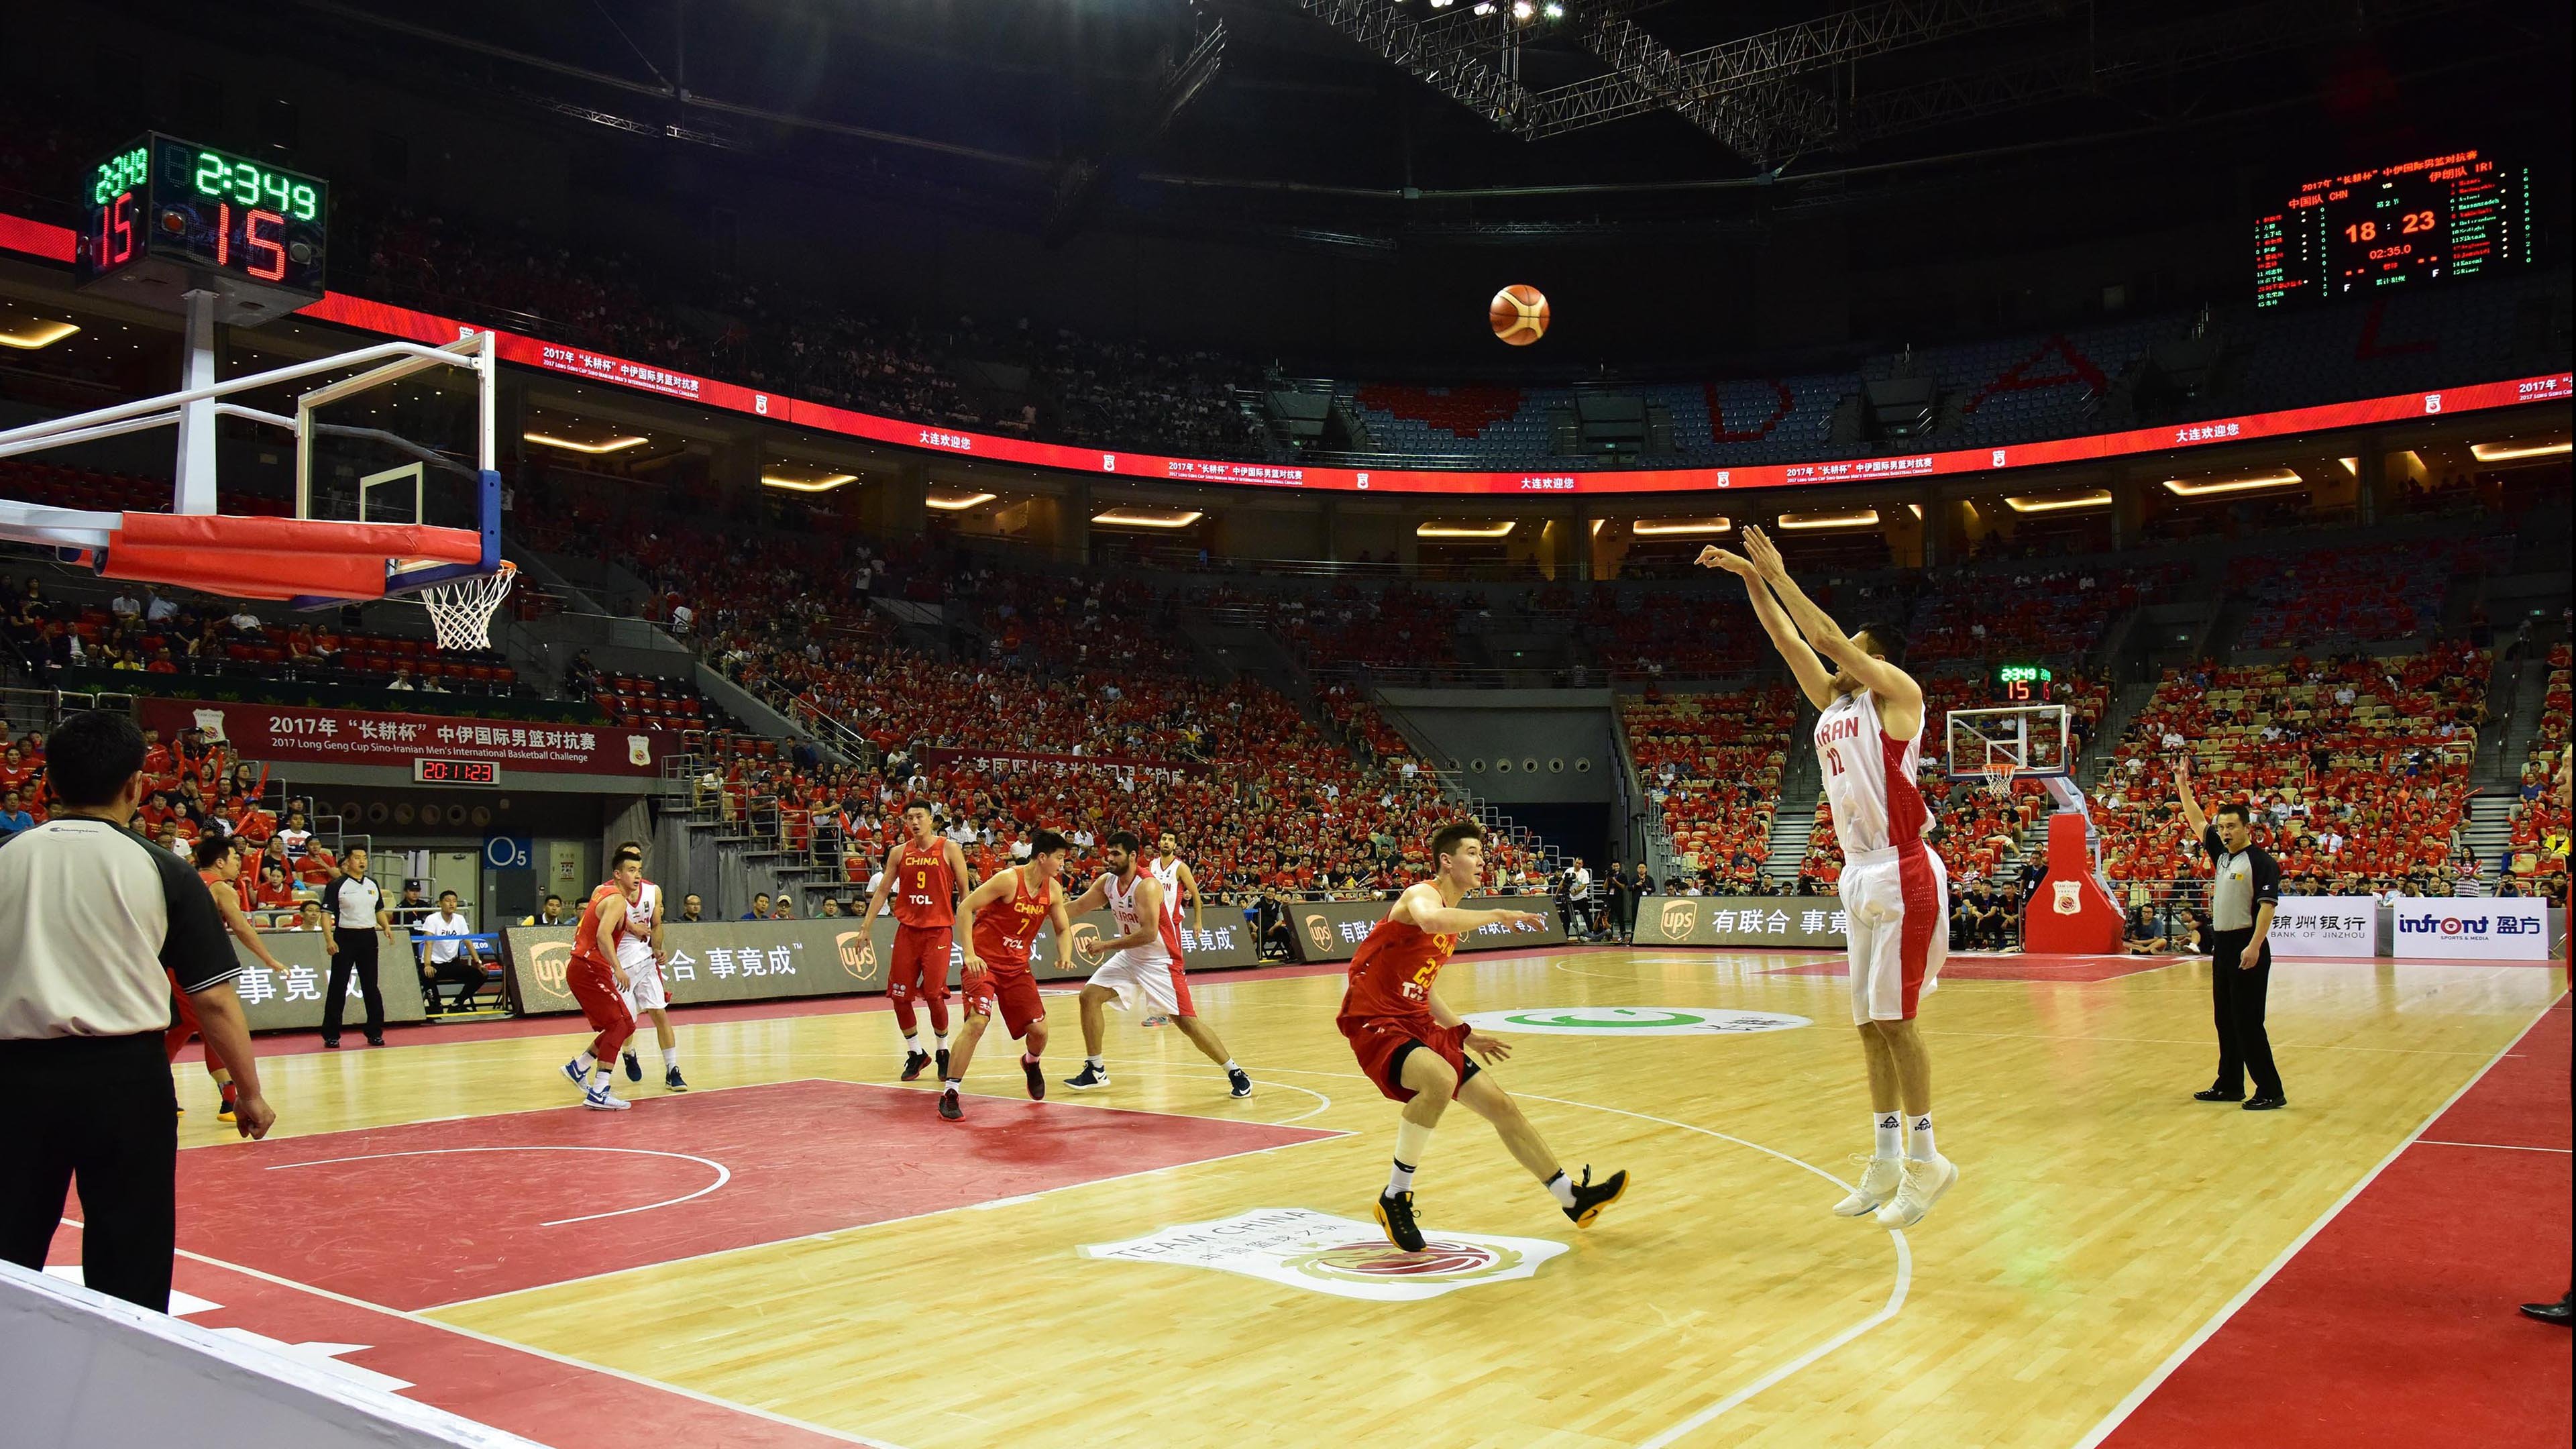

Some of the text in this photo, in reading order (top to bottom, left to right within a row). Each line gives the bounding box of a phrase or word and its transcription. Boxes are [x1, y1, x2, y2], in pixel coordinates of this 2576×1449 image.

[2428, 167, 2467, 182] 伊朗队
[2475, 161, 2493, 172] IRI
[2289, 190, 2348, 209] 中国队 CHN
[103, 192, 131, 268] 15
[2345, 221, 2375, 243] 18
[2402, 211, 2435, 234] 23
[218, 203, 286, 281] 15
[2369, 244, 2411, 260] 02:35.0
[2432, 269, 2439, 277] F
[2344, 284, 2351, 292] F
[543, 347, 574, 363] 2017年
[621, 364, 698, 392] 中伊国际男篮对抗赛
[2519, 379, 2557, 393] 2017年
[920, 430, 971, 449] 大连欢迎您
[2176, 423, 2239, 443] 大连欢迎您
[1169, 462, 1194, 472] 2017年
[1233, 467, 1302, 480] 中伊国际男篮对抗赛
[1786, 467, 1814, 476] 2017年
[1856, 458, 1932, 473] 中伊国际男篮对抗赛
[1521, 477, 1574, 489] 大连欢迎您
[2009, 680, 2029, 700] 15
[269, 716, 596, 751] 2017年 “长耕杯” 中伊国际男篮对抗赛
[272, 738, 588, 763] 2017 Long Geng Cup Sino-Iranian Men's International Basketball Challenge
[1827, 747, 1845, 776] 12
[424, 762, 491, 781] 20:11:23
[906, 857, 939, 866] CHINA
[917, 871, 926, 889] 9
[909, 895, 933, 904] TCL
[1014, 902, 1044, 914] CHINA
[1016, 918, 1030, 934] 7
[1664, 912, 1693, 934] ups
[1712, 909, 1790, 934] 有联合
[2272, 915, 2366, 930] 锦州银行
[2400, 914, 2540, 934] infront 盈方
[1002, 936, 1024, 949] TCL
[1311, 926, 1330, 946] ups
[706, 943, 796, 979] 事竟成
[537, 958, 570, 989] up
[1107, 1210, 1318, 1258] TEAM CHINA
